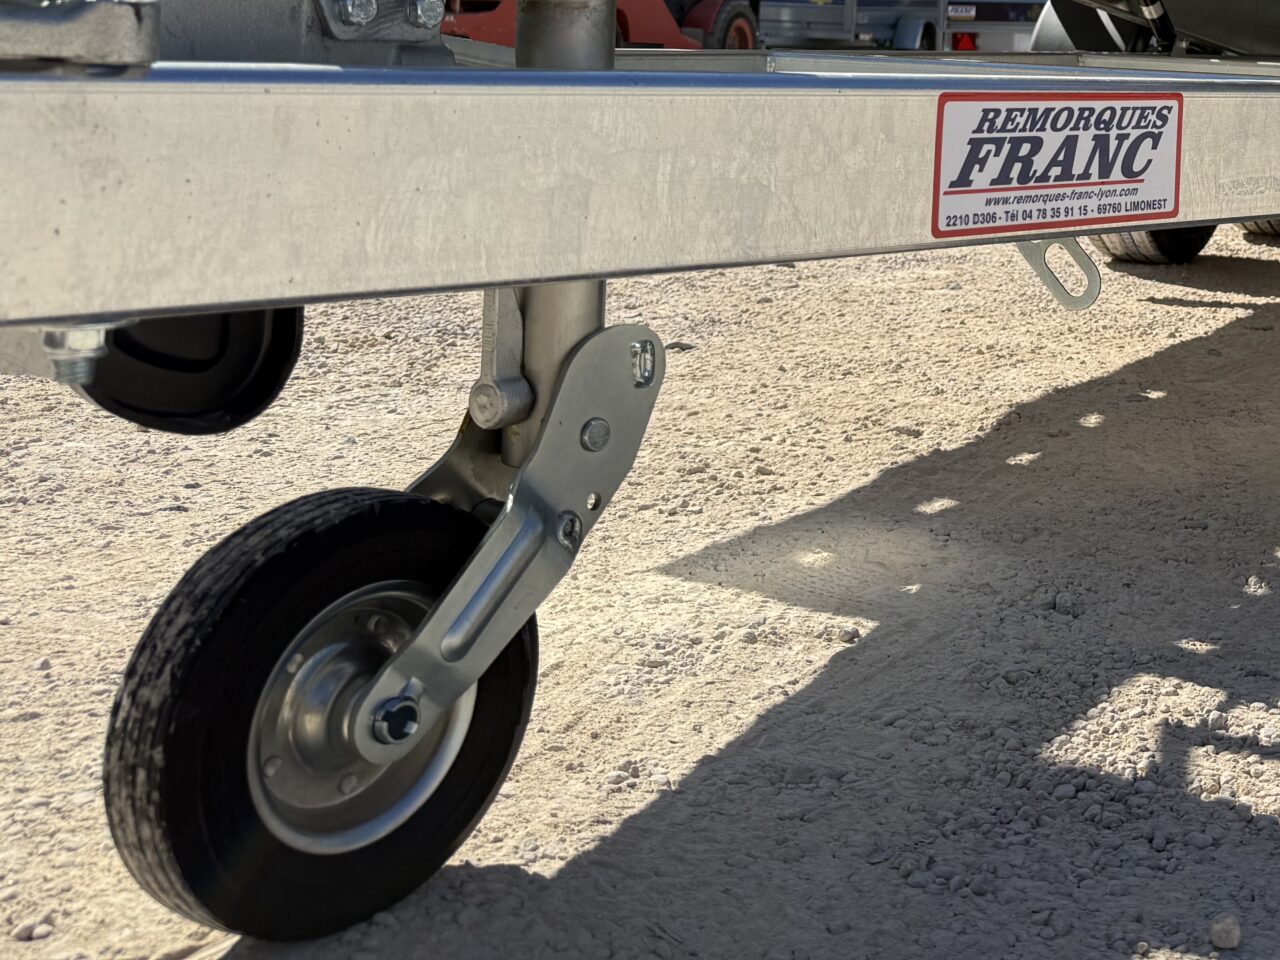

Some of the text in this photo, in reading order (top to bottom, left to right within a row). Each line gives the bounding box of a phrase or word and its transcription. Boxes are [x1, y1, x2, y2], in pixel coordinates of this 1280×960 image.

[971, 105, 1173, 134] REMORQUES
[948, 130, 1163, 189] FRANC
[985, 187, 1138, 207] www.remorques-franc-lyon.com
[946, 214, 969, 227] 2210
[972, 211, 997, 225] D306
[1004, 208, 1018, 222] Tél
[1022, 208, 1033, 221] 04
[1036, 207, 1047, 219] 78
[1050, 206, 1061, 219] 35
[1064, 205, 1074, 217] 91
[1079, 203, 1088, 216] 15
[1097, 202, 1122, 214] 69760
[1125, 198, 1167, 212] LIMONEST
